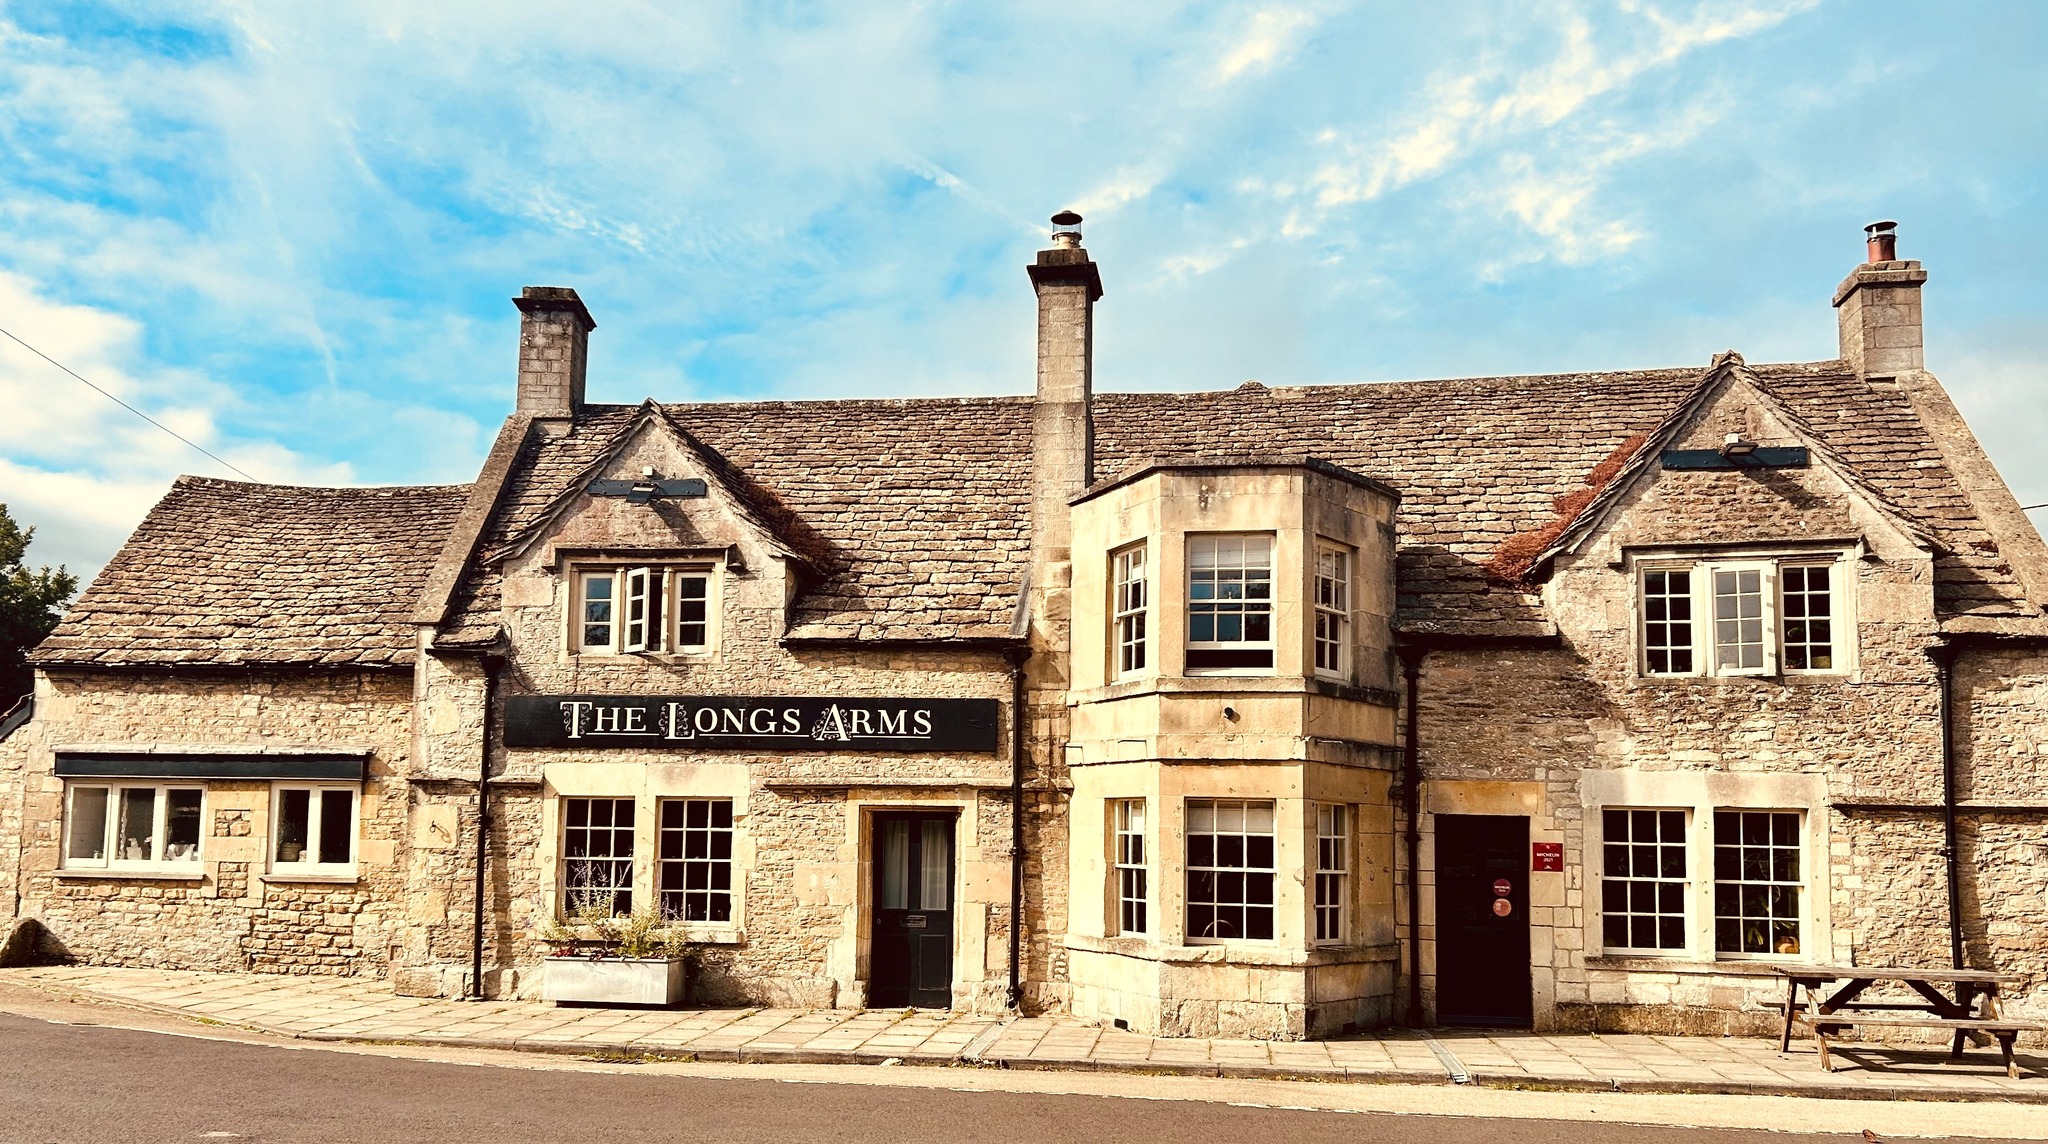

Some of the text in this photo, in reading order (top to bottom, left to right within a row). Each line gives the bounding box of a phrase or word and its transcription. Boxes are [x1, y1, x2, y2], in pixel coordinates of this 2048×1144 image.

[560, 701, 932, 742] THE LONGS ARMS
